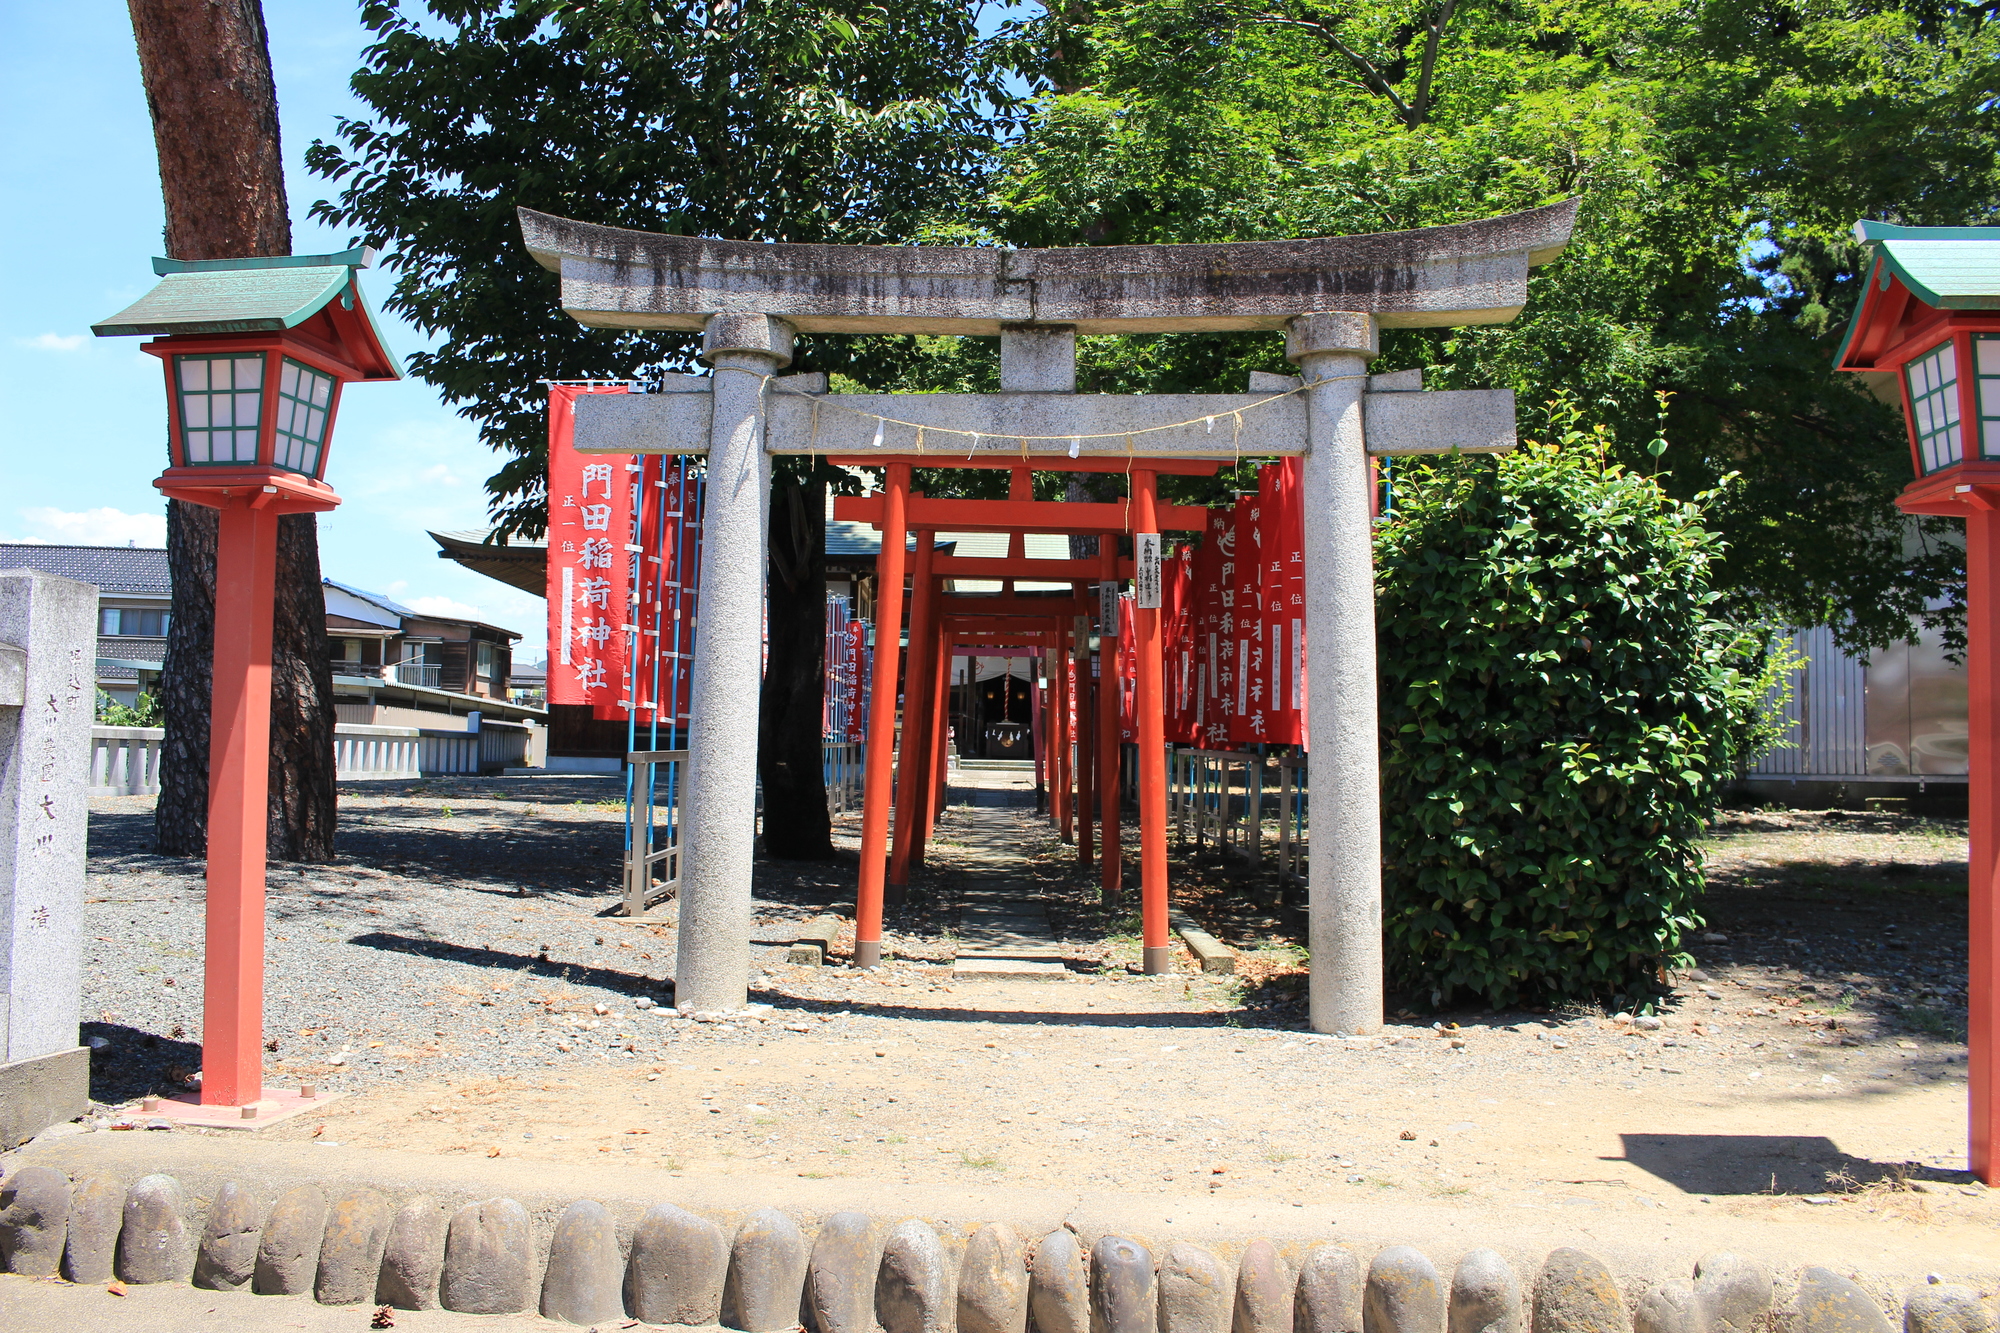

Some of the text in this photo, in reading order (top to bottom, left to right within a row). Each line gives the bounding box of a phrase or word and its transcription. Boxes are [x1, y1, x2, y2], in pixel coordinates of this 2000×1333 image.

[561, 495, 576, 553] 正一位
[576, 463, 614, 691] 門田稲荷神社
[1270, 561, 1282, 612] 正一位
[1290, 551, 1302, 605] 正一位
[1180, 607, 1189, 643] 正一位
[1208, 583, 1218, 623] 正一位
[1240, 583, 1252, 629] 正一位
[1206, 723, 1229, 743] 社
